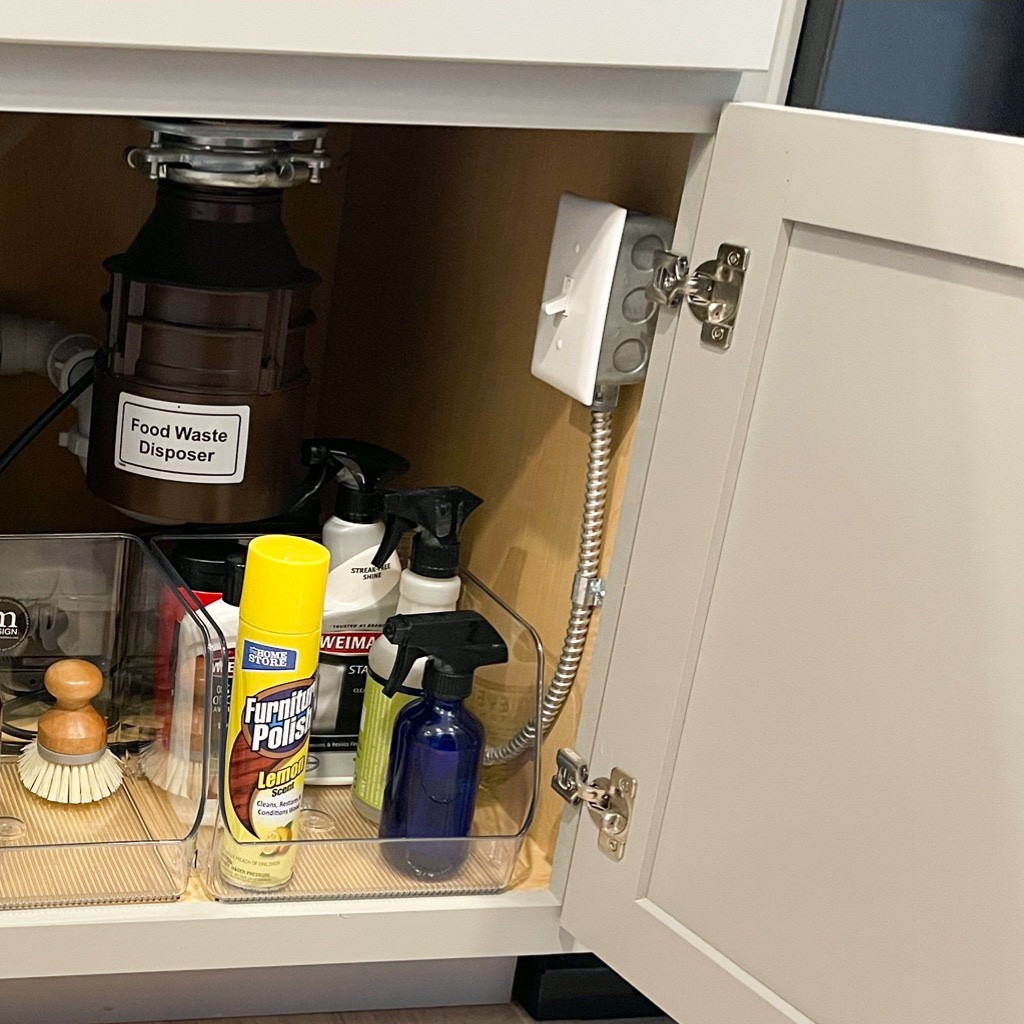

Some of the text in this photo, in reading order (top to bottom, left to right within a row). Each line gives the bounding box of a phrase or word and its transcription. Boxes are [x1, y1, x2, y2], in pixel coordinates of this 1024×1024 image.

[131, 418, 228, 442] Food Waste
[140, 440, 215, 462] Disposer
[363, 572, 382, 580] SHINE
[248, 656, 287, 667] STORE
[256, 650, 287, 660] HOME
[257, 756, 305, 790] Lemon
[272, 782, 294, 797] Scent
[258, 808, 288, 816] Conditions
